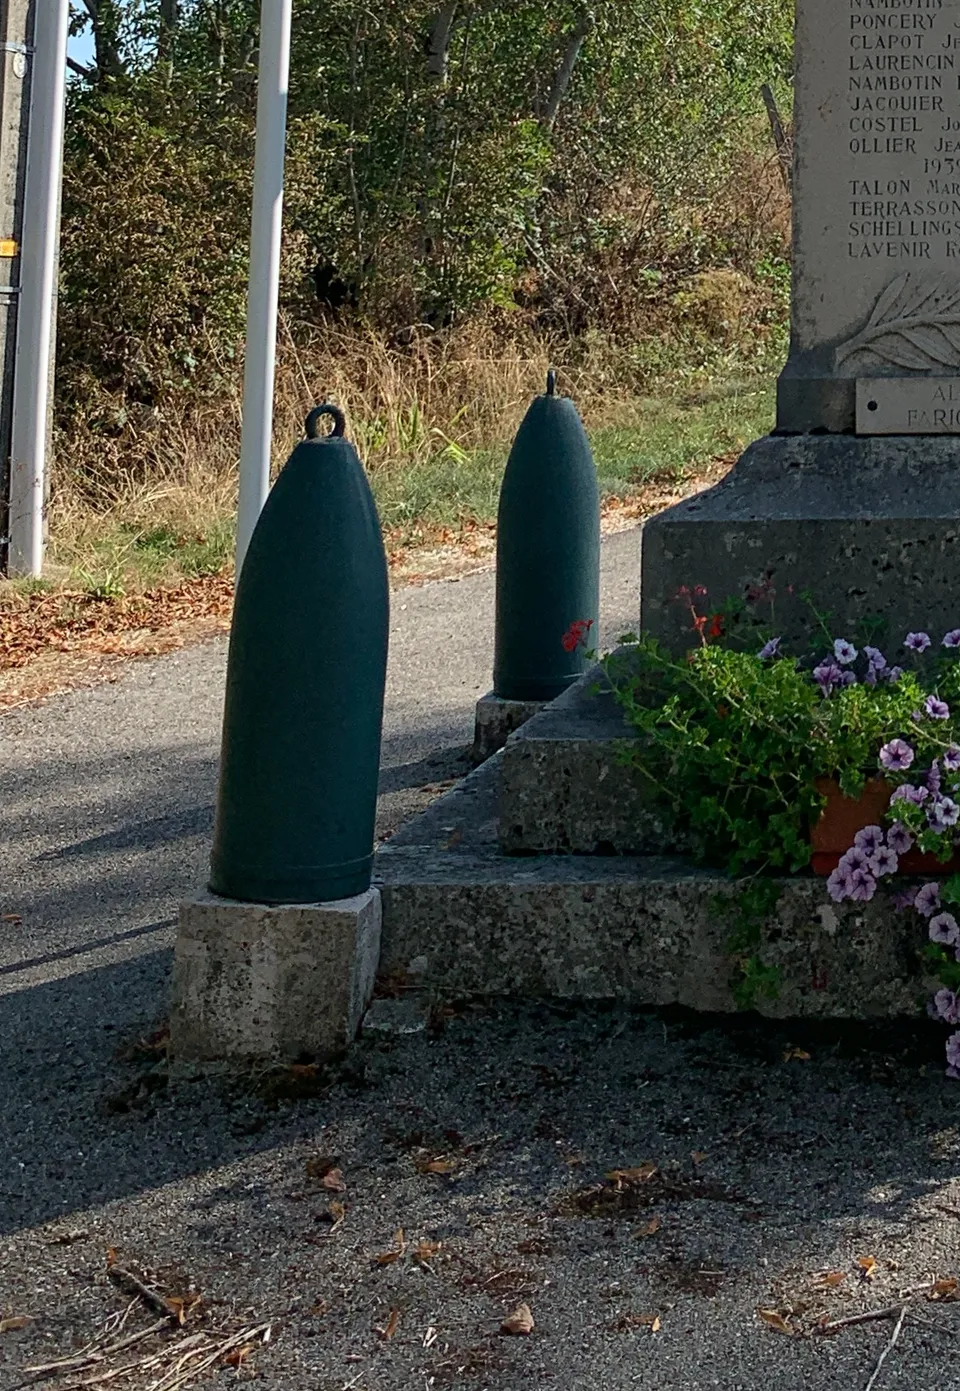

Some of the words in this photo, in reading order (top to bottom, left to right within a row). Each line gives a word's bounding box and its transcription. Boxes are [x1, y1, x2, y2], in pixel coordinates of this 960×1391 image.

[850, 14, 937, 30] PONCERY
[850, 34, 925, 50] CLAPOT
[849, 54, 955, 72] LAURENCIN
[849, 75, 942, 91] NAMBOTIN
[849, 116, 923, 132] COSTEL
[849, 137, 917, 154] OLLIER
[849, 179, 911, 196] TALON
[848, 241, 931, 259] LAVENIR
